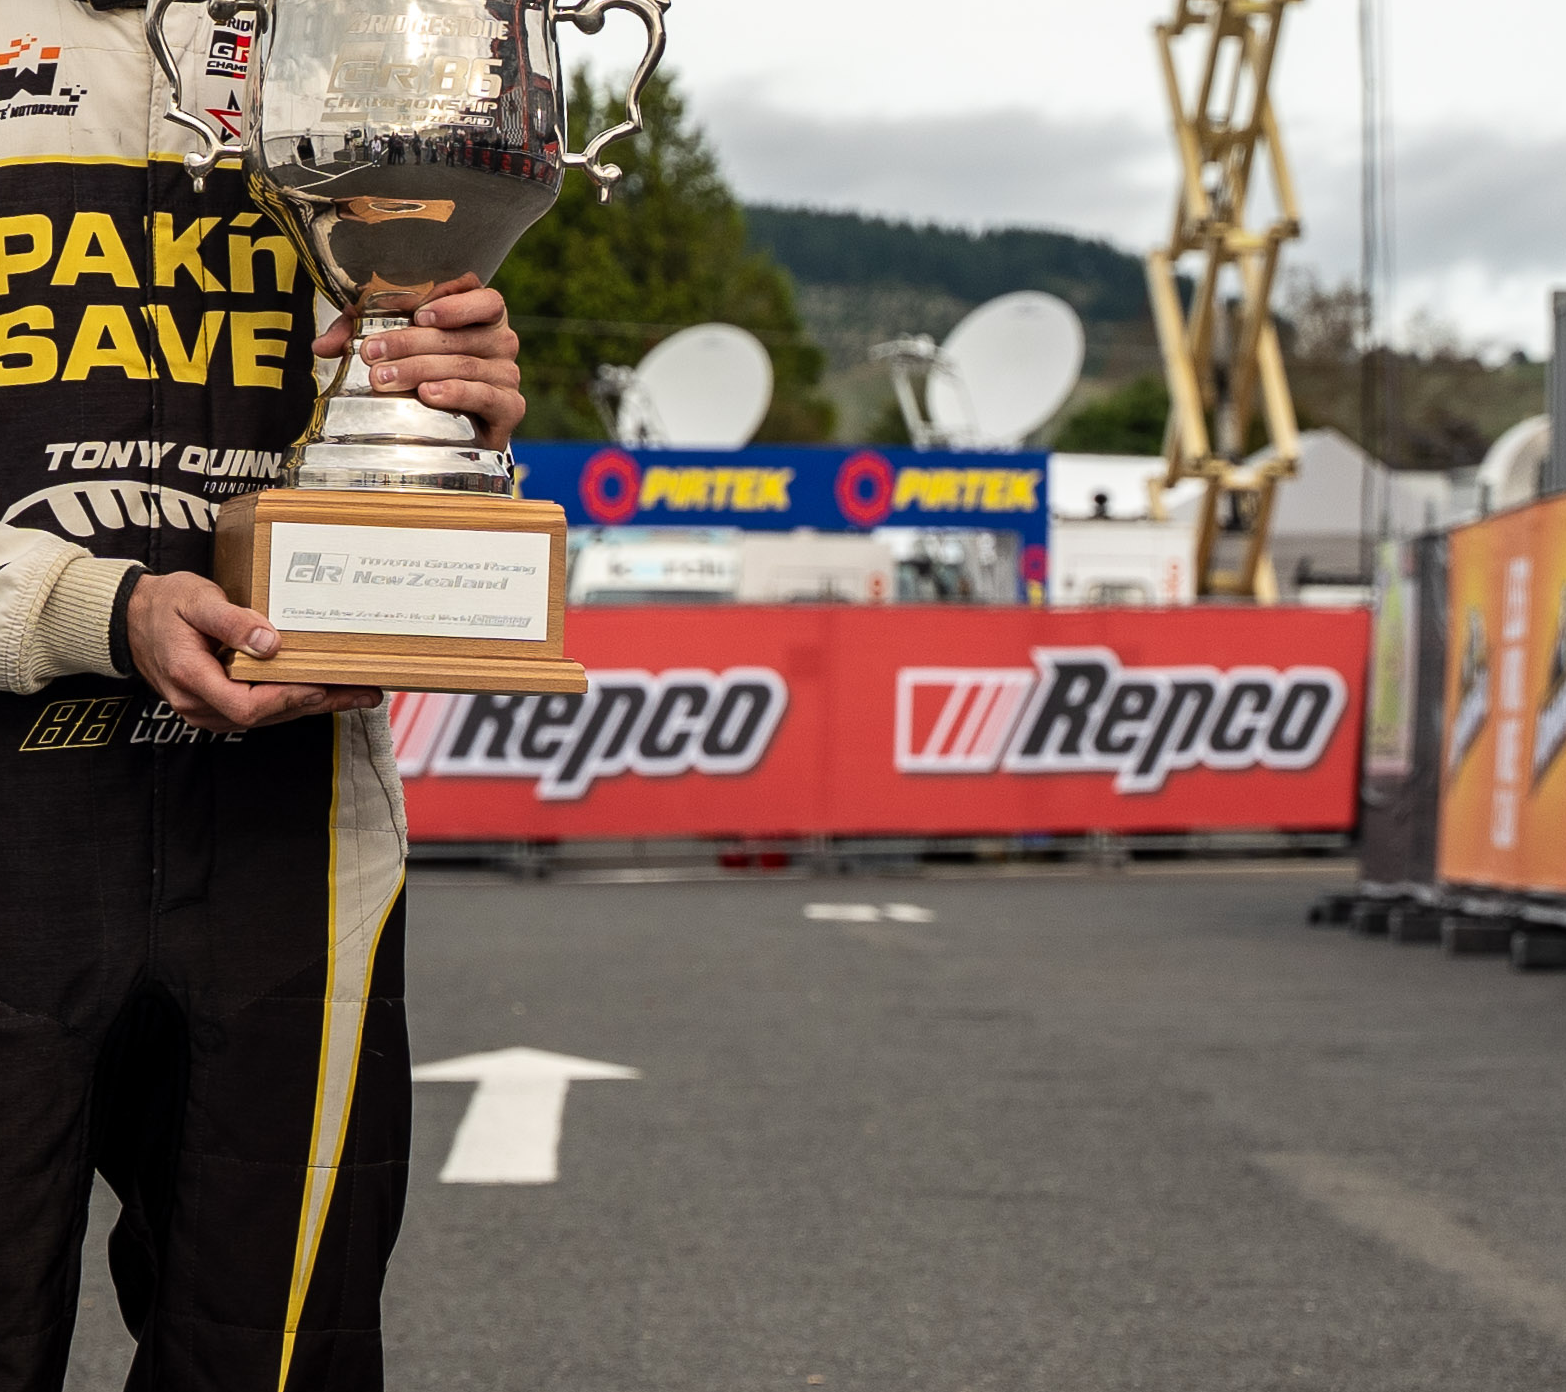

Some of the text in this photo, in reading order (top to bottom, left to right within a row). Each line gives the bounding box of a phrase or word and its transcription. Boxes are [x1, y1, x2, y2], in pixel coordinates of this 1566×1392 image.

[348, 10, 510, 41] BRIDGESTONE
[432, 56, 503, 99] 86
[10, 104, 78, 119] MOTORSPORT
[324, 96, 498, 114] CHAMPIONSHIP
[44, 440, 283, 479] TONY QUINN
[638, 465, 795, 512] PIRTEK
[892, 467, 1043, 513] PIRTEK
[352, 570, 510, 591] New Zealand
[483, 560, 538, 575] Racing
[19, 696, 134, 752] 88
[442, 675, 781, 793] Repco
[1012, 651, 1340, 787] Repco
